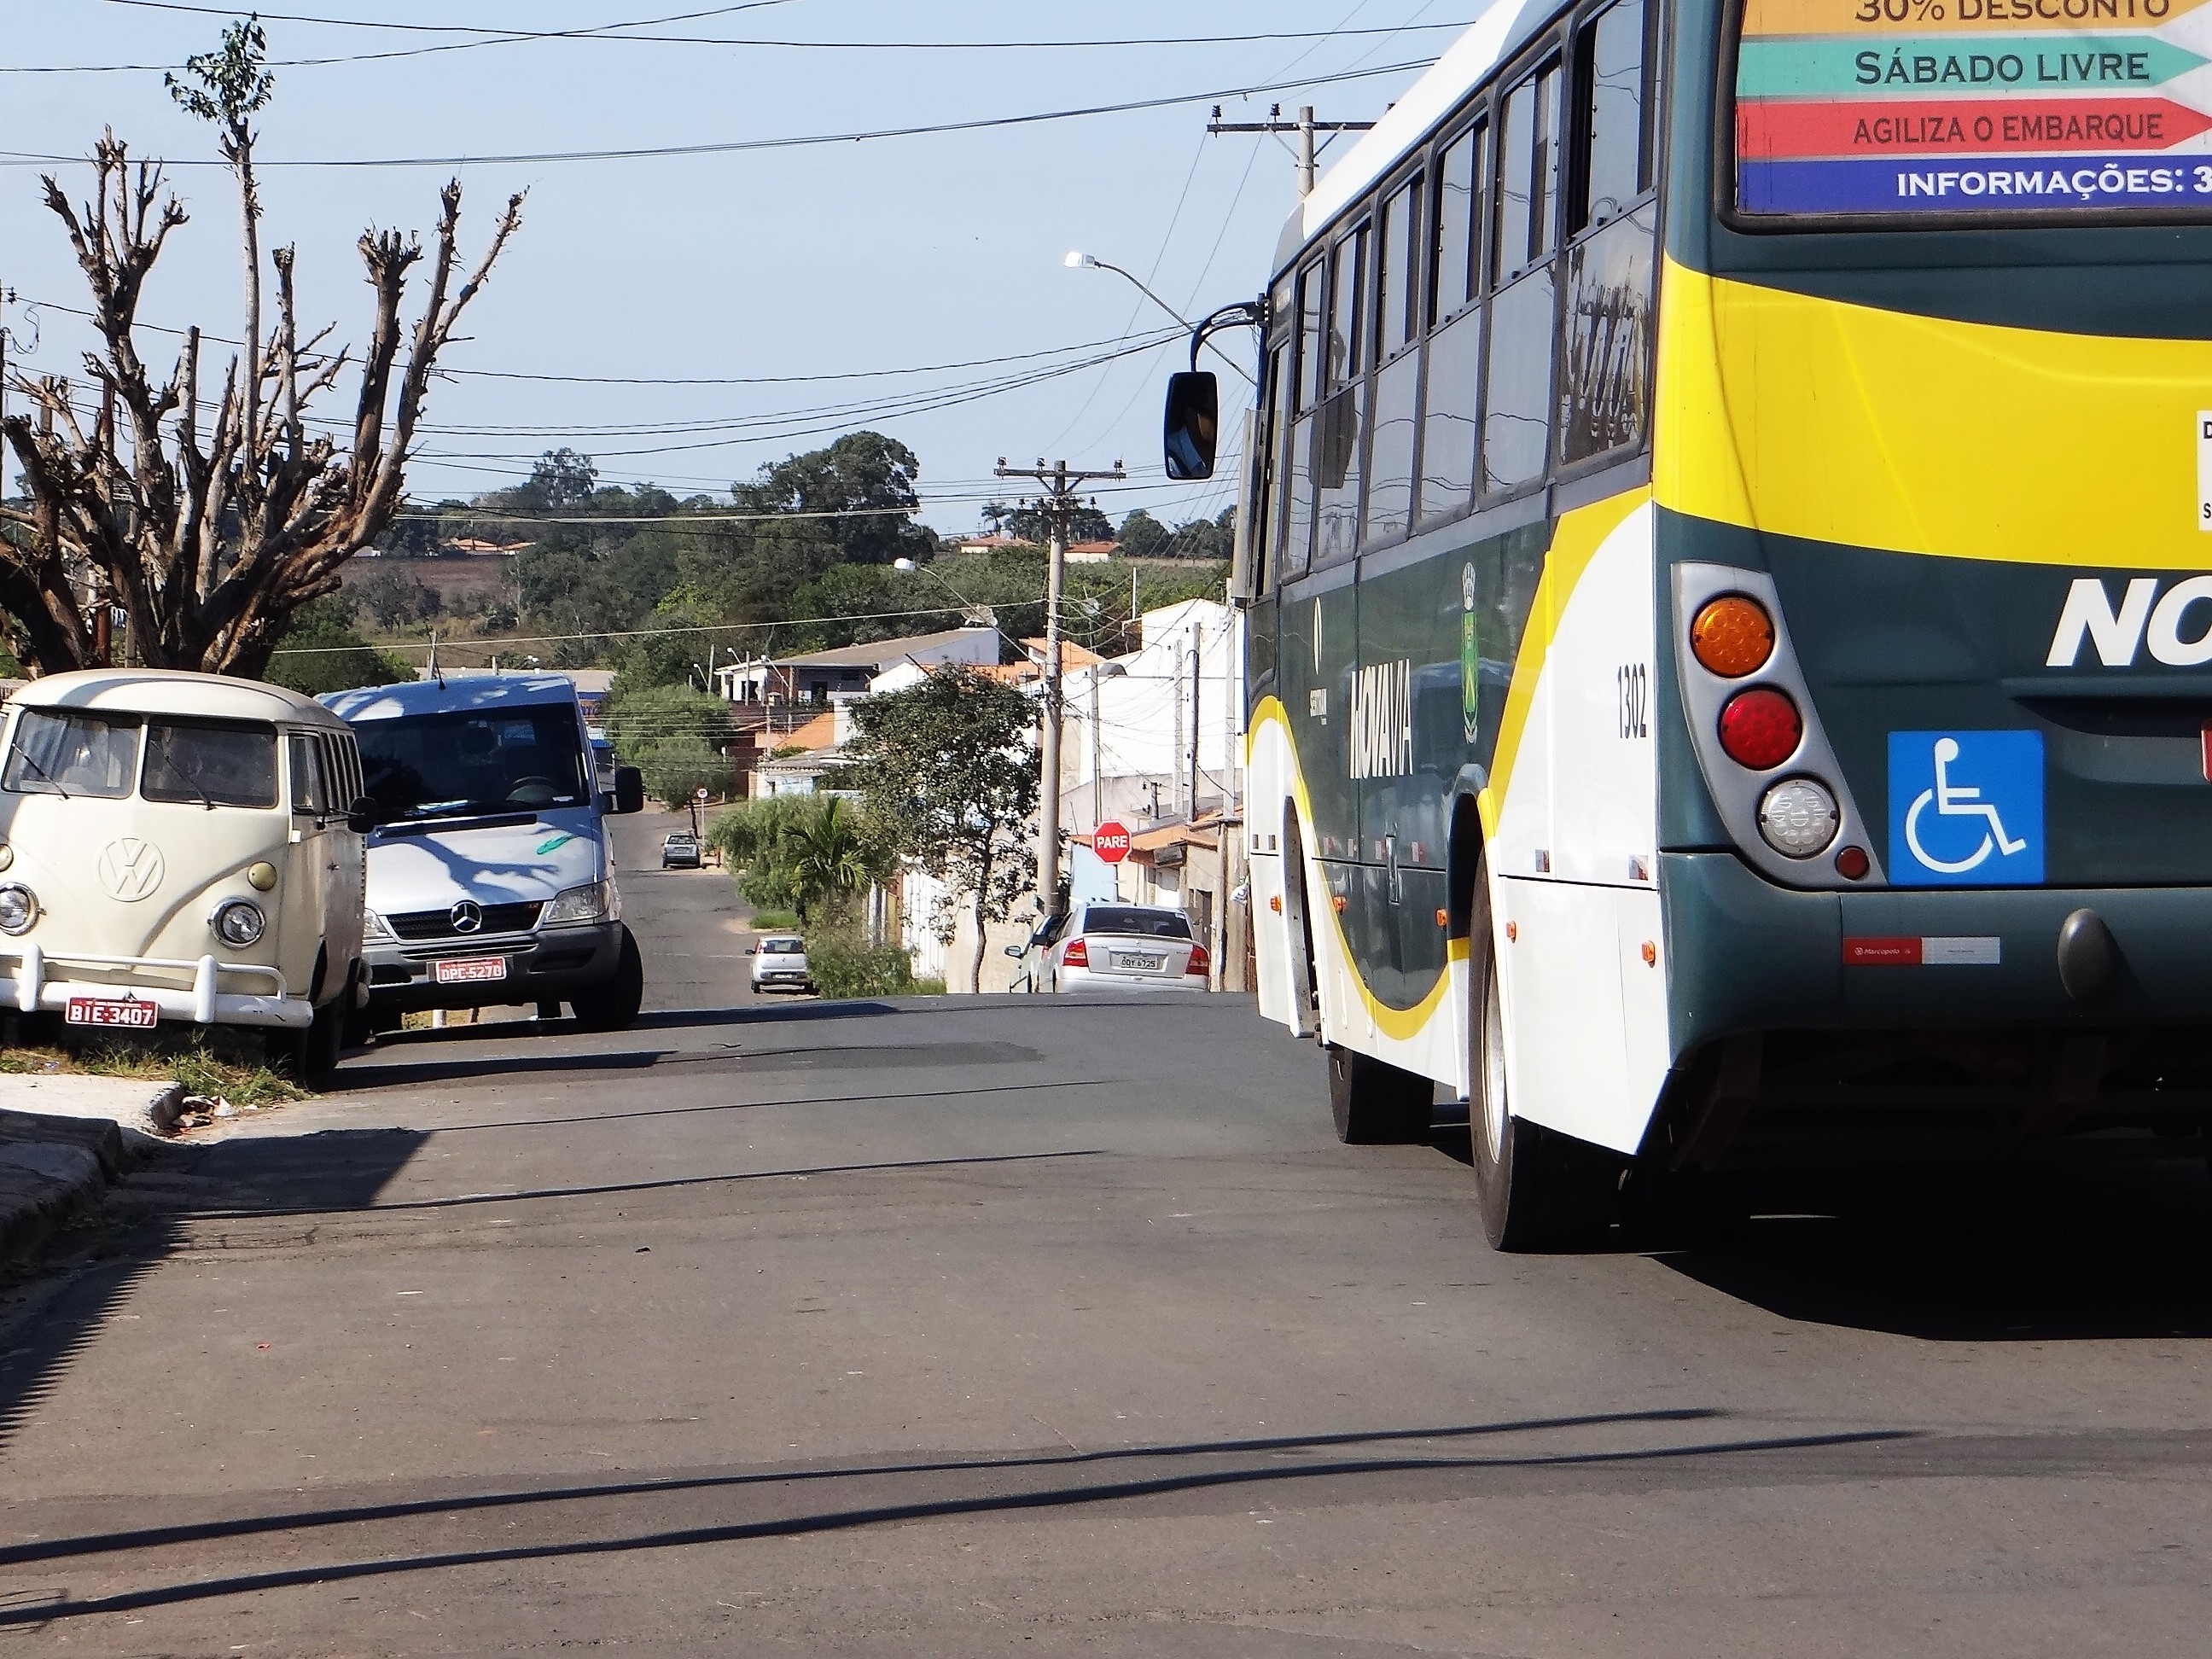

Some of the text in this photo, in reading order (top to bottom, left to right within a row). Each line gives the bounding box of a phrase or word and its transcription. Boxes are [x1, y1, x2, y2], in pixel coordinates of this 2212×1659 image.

[1855, 0, 2170, 22] 30% DESCONTO
[1854, 47, 2151, 84] SÁBADO LIVRE
[1852, 114, 2164, 144] AGILIZA O EMBARQUE
[1897, 162, 2184, 201] INFORMAÇÕES:
[1617, 662, 1647, 739] 1302
[1096, 835, 1128, 849] PARE
